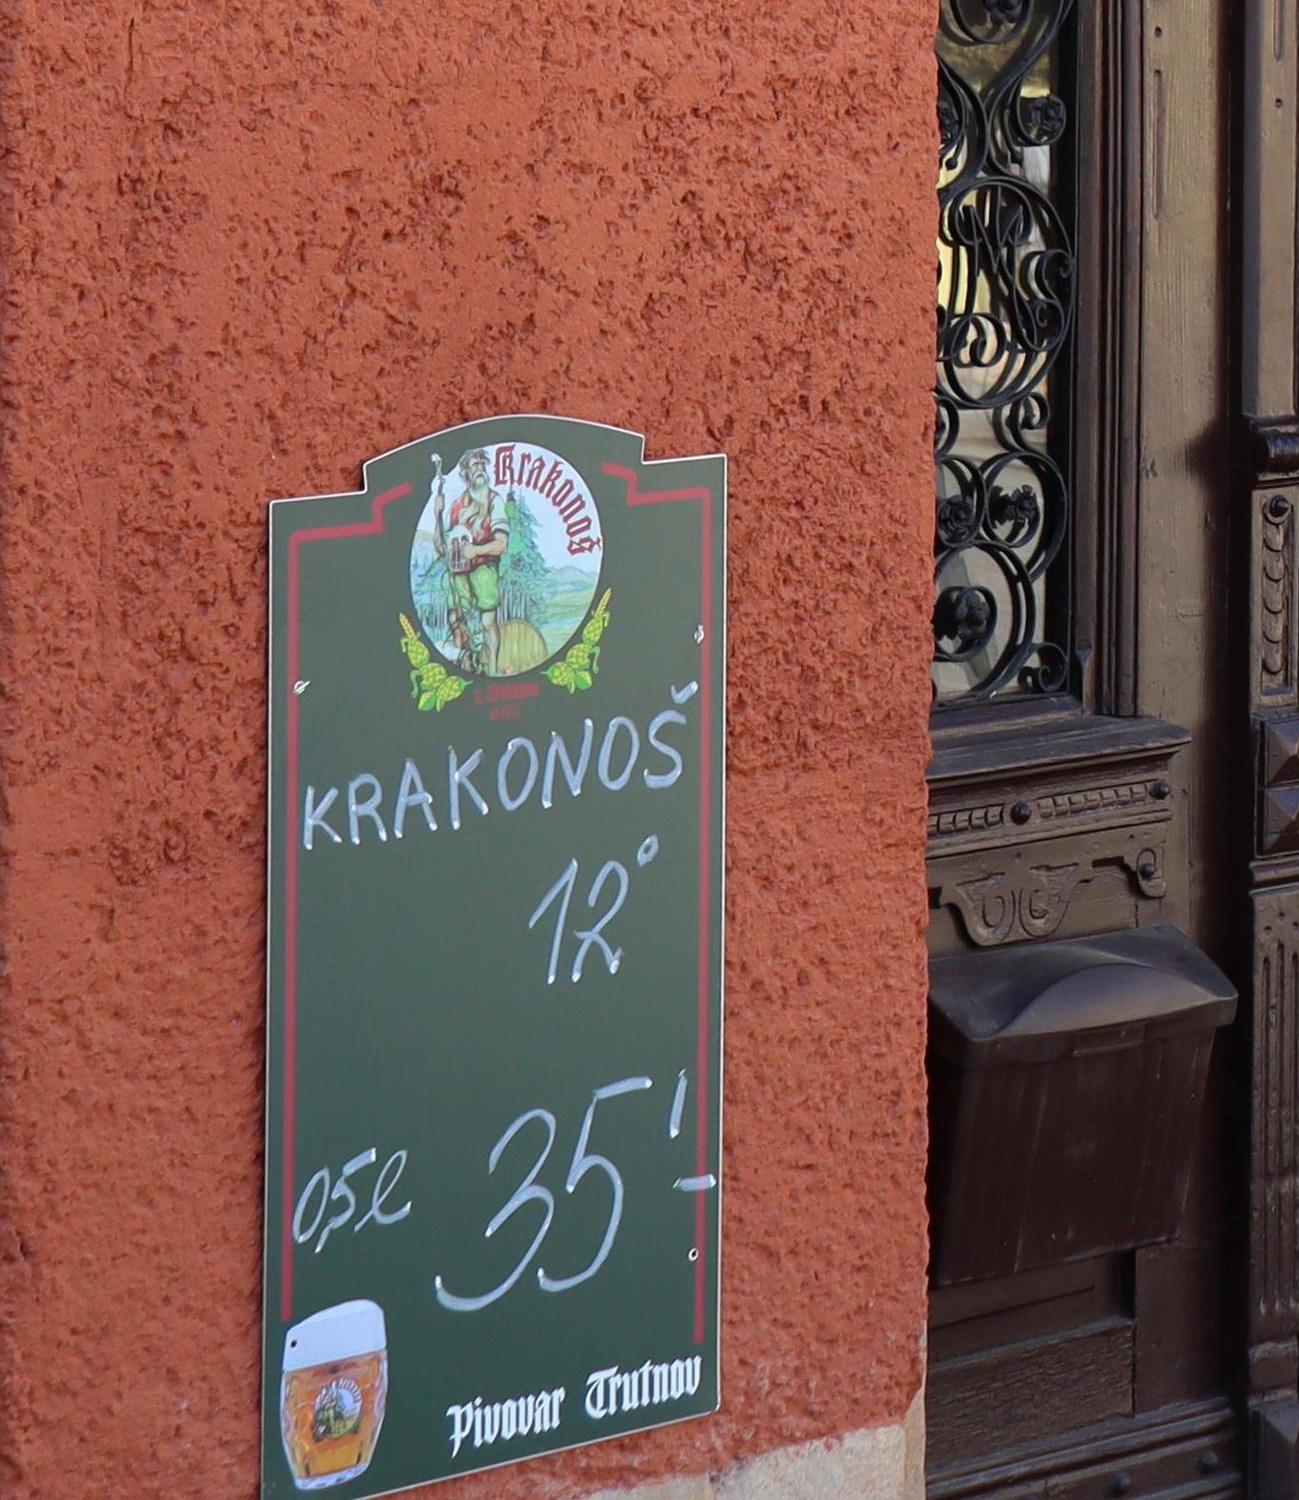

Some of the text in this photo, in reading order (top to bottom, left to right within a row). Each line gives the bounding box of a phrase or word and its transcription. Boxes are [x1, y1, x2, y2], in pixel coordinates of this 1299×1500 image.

[302, 680, 700, 852] KRAKONOŠ
[446, 1355, 702, 1459] Pivovar Trutnov
